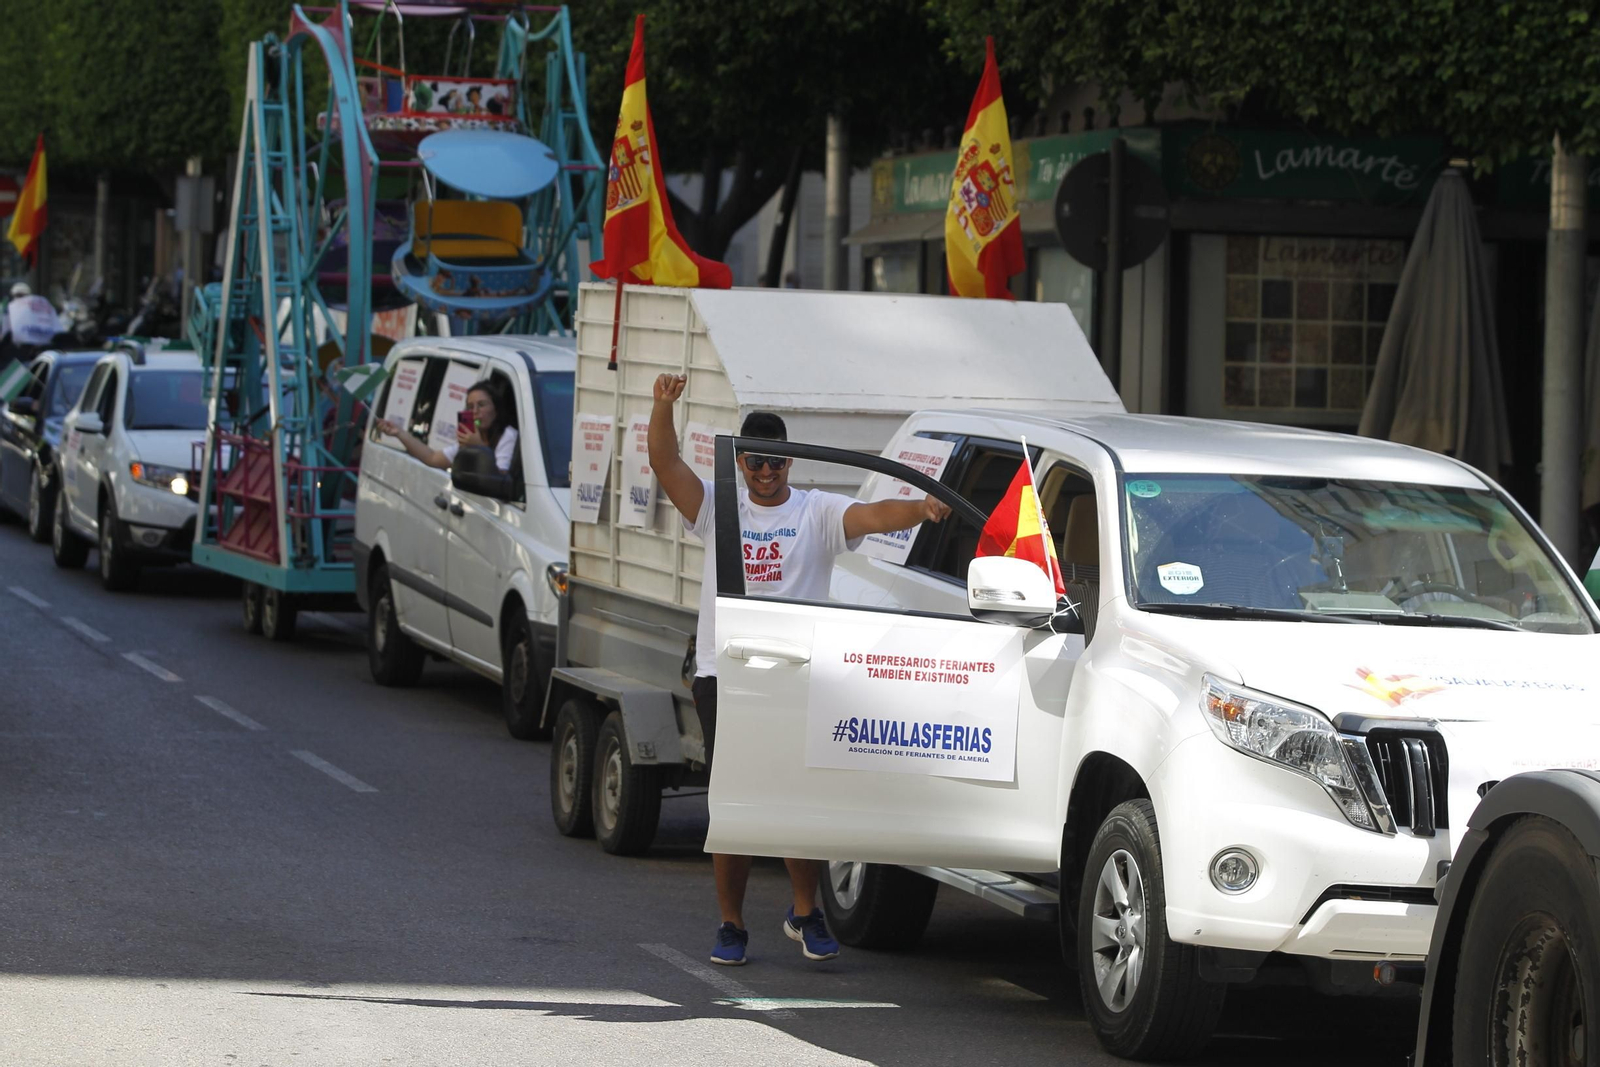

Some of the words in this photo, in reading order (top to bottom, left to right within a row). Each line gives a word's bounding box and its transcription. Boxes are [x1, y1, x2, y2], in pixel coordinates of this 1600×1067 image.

[1254, 143, 1421, 191] Lamarté
[742, 527, 797, 542] ALVALASERIAS
[844, 652, 863, 664] LOS
[866, 654, 937, 669] EMPRESARIOS
[940, 659, 995, 673] FERIANTES
[867, 667, 911, 681] TAMBIÉN
[915, 671, 969, 685] EXISTIMOS
[832, 717, 992, 754] #SALVALASFERIAS
[848, 746, 893, 756] ASOCIACIÓN
[905, 750, 945, 760] FERIANTES
[958, 755, 990, 764] ALMERÍA
